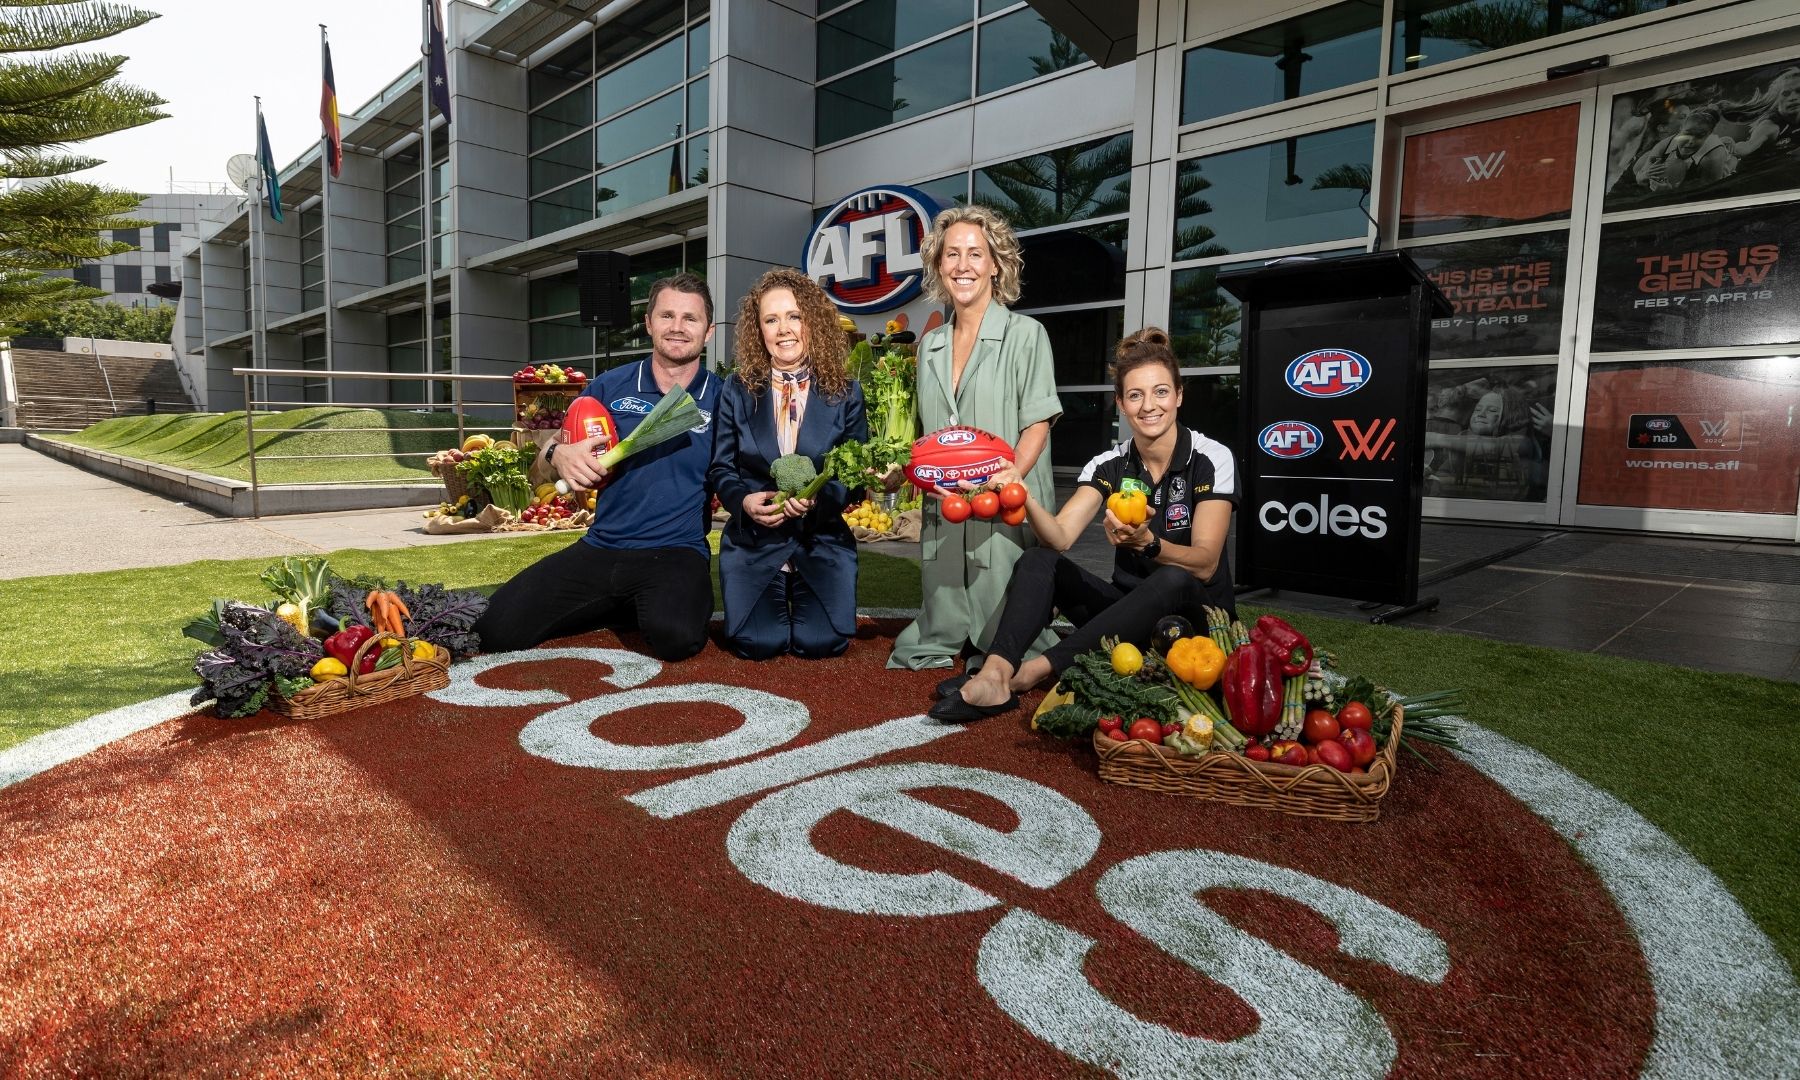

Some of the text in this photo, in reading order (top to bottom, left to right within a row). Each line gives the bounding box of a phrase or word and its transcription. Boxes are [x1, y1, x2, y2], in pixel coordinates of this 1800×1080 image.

[808, 210, 924, 286] AFL
[1636, 244, 1779, 275] THIS IS
[1427, 261, 1552, 285] HIS IS THE
[1441, 277, 1550, 299] TURE OF
[1634, 298, 1669, 309] FEB
[1673, 296, 1686, 306] 7
[1705, 292, 1748, 304] APR
[1752, 290, 1773, 300] 18
[1431, 320, 1451, 329] EB
[1453, 319, 1463, 327] 7
[1477, 315, 1510, 326] APR
[1512, 314, 1529, 323] 18
[1293, 360, 1363, 386] AFL
[619, 399, 647, 412] Ford
[1648, 421, 1669, 429] AFL
[1264, 430, 1317, 449] AFL
[1652, 433, 1678, 443] nab
[917, 463, 1001, 479] AFL TOYOTA
[1625, 460, 1740, 471] womens.afl
[1168, 507, 1187, 517] AFL
[1258, 493, 1388, 539] coles
[425, 647, 1449, 1080] coles
